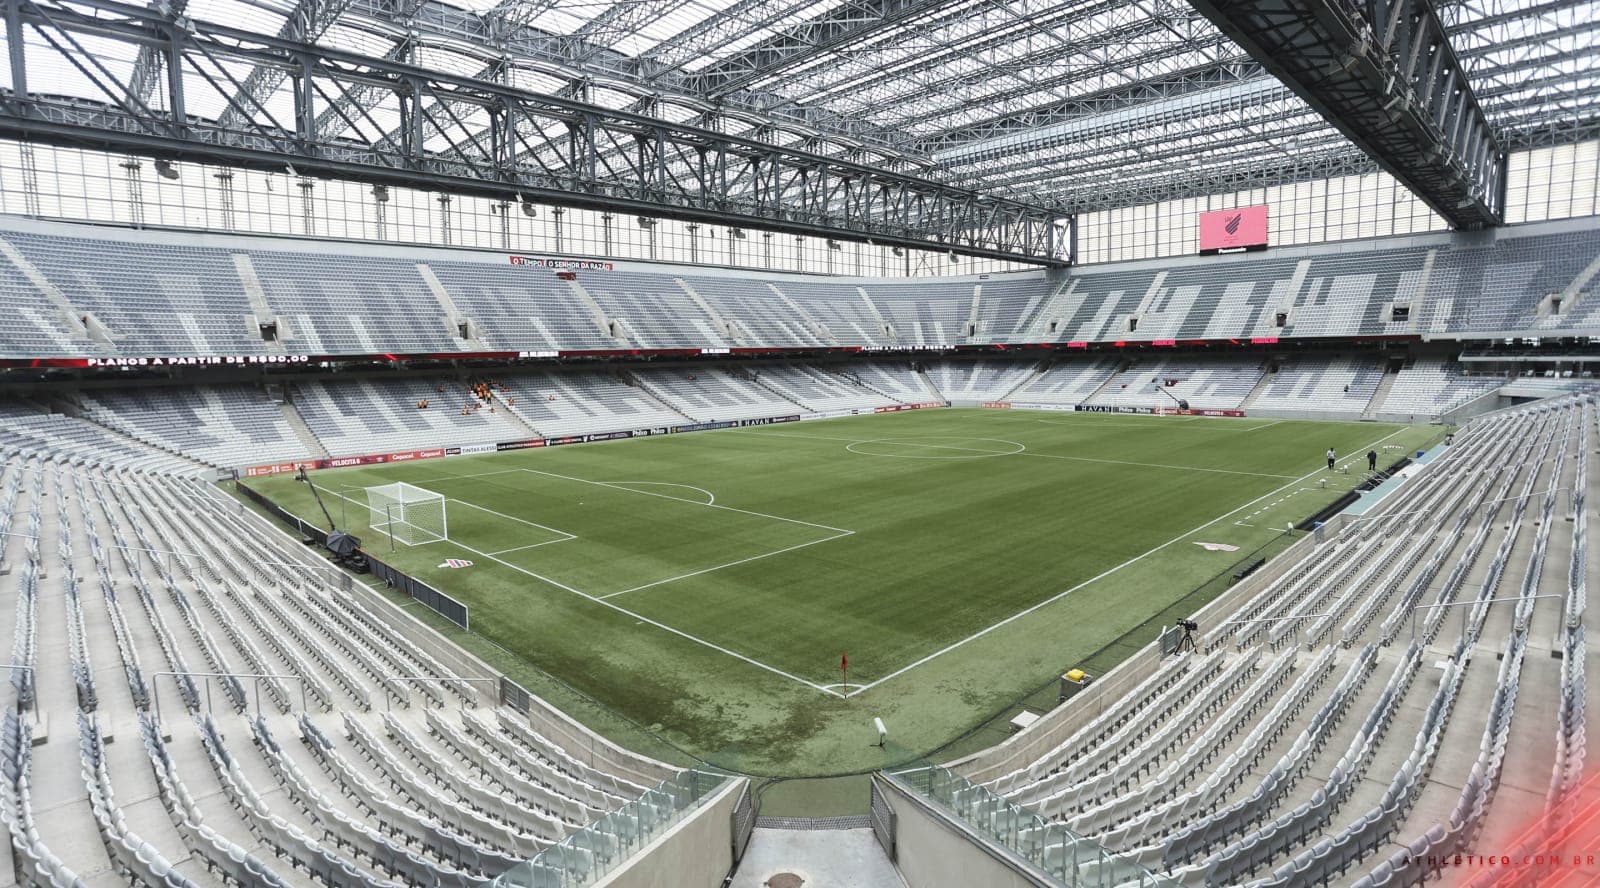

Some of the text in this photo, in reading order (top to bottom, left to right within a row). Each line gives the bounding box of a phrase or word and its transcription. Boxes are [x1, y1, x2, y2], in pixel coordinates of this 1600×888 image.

[519, 258, 541, 267] TEMPO
[548, 259, 554, 267] O
[554, 260, 580, 269] SENHOR
[580, 262, 590, 270] DA
[87, 358, 148, 366] PLANOS
[153, 357, 163, 365] A
[168, 356, 221, 365] PARTIR
[226, 356, 245, 364] DE
[745, 418, 770, 427] HAVAN
[632, 429, 648, 437] Philco
[650, 427, 665, 435] Philco
